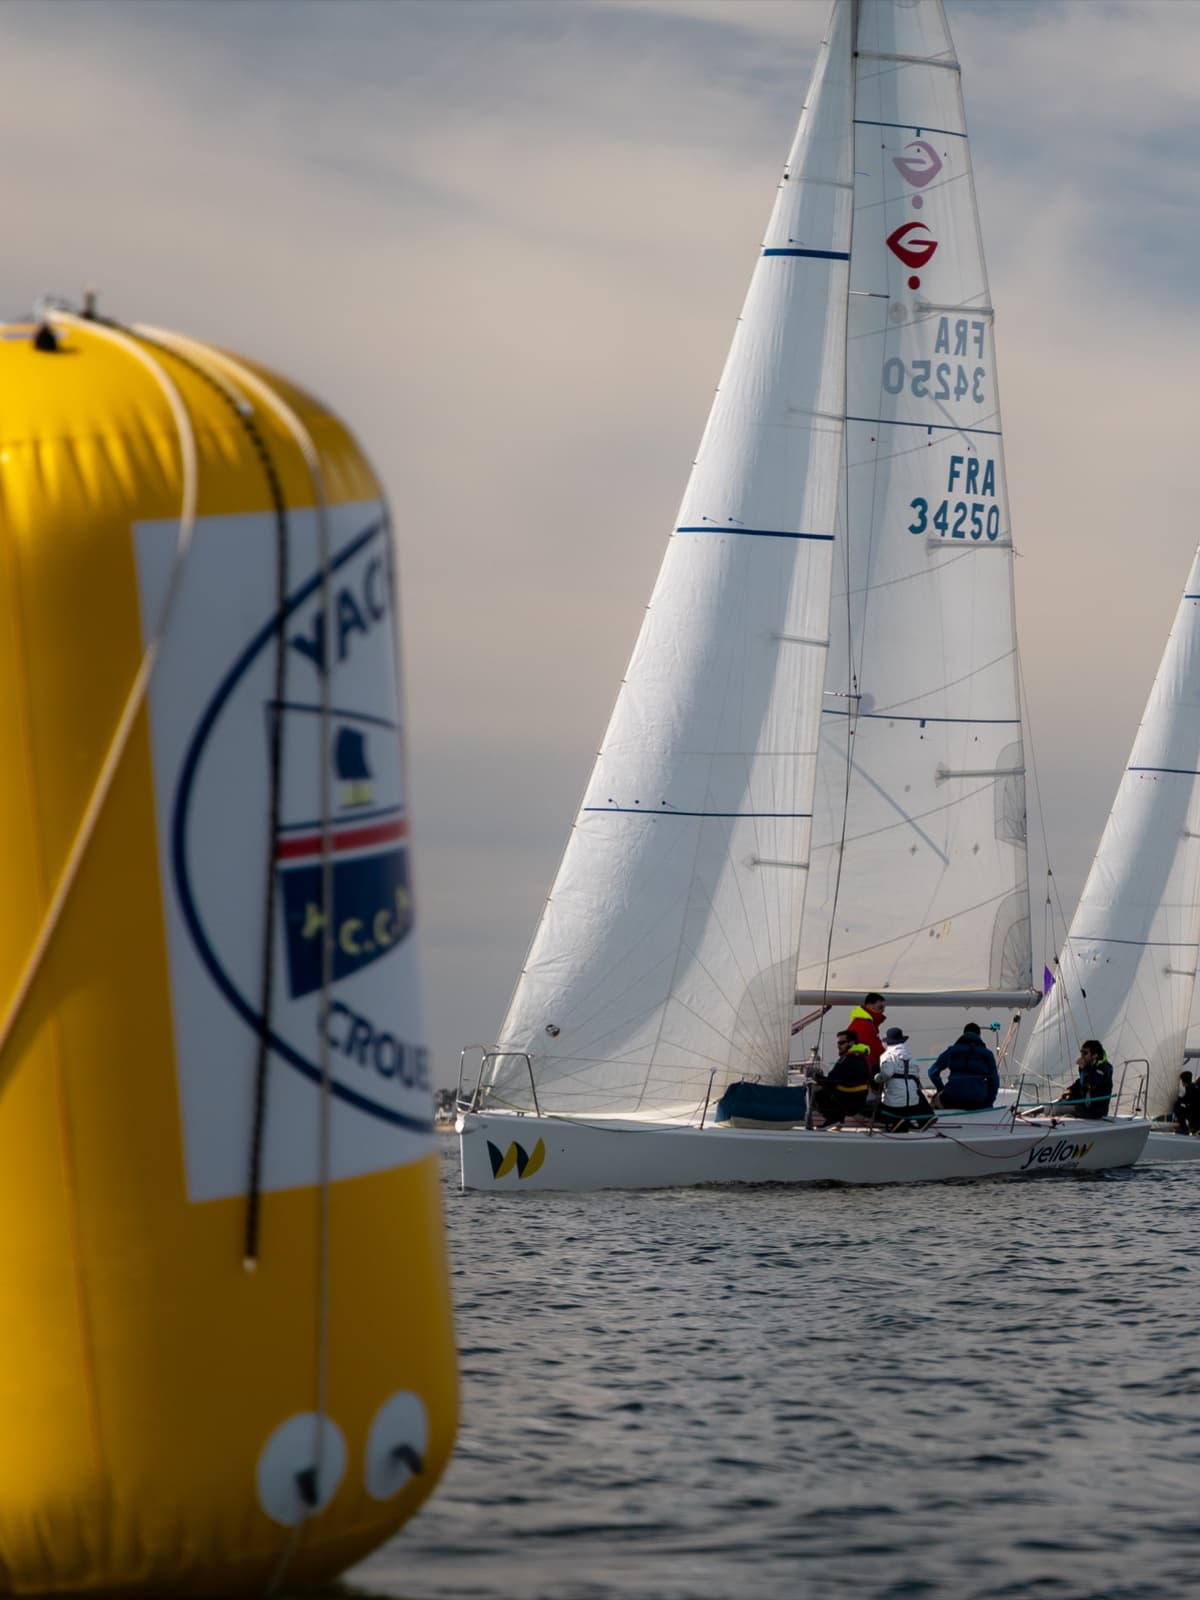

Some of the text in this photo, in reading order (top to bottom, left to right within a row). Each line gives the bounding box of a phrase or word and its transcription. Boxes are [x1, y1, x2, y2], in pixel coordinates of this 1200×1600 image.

[948, 455, 996, 497] FRA
[908, 497, 1000, 541] 34250
[1020, 1139, 1095, 1170] yellow
